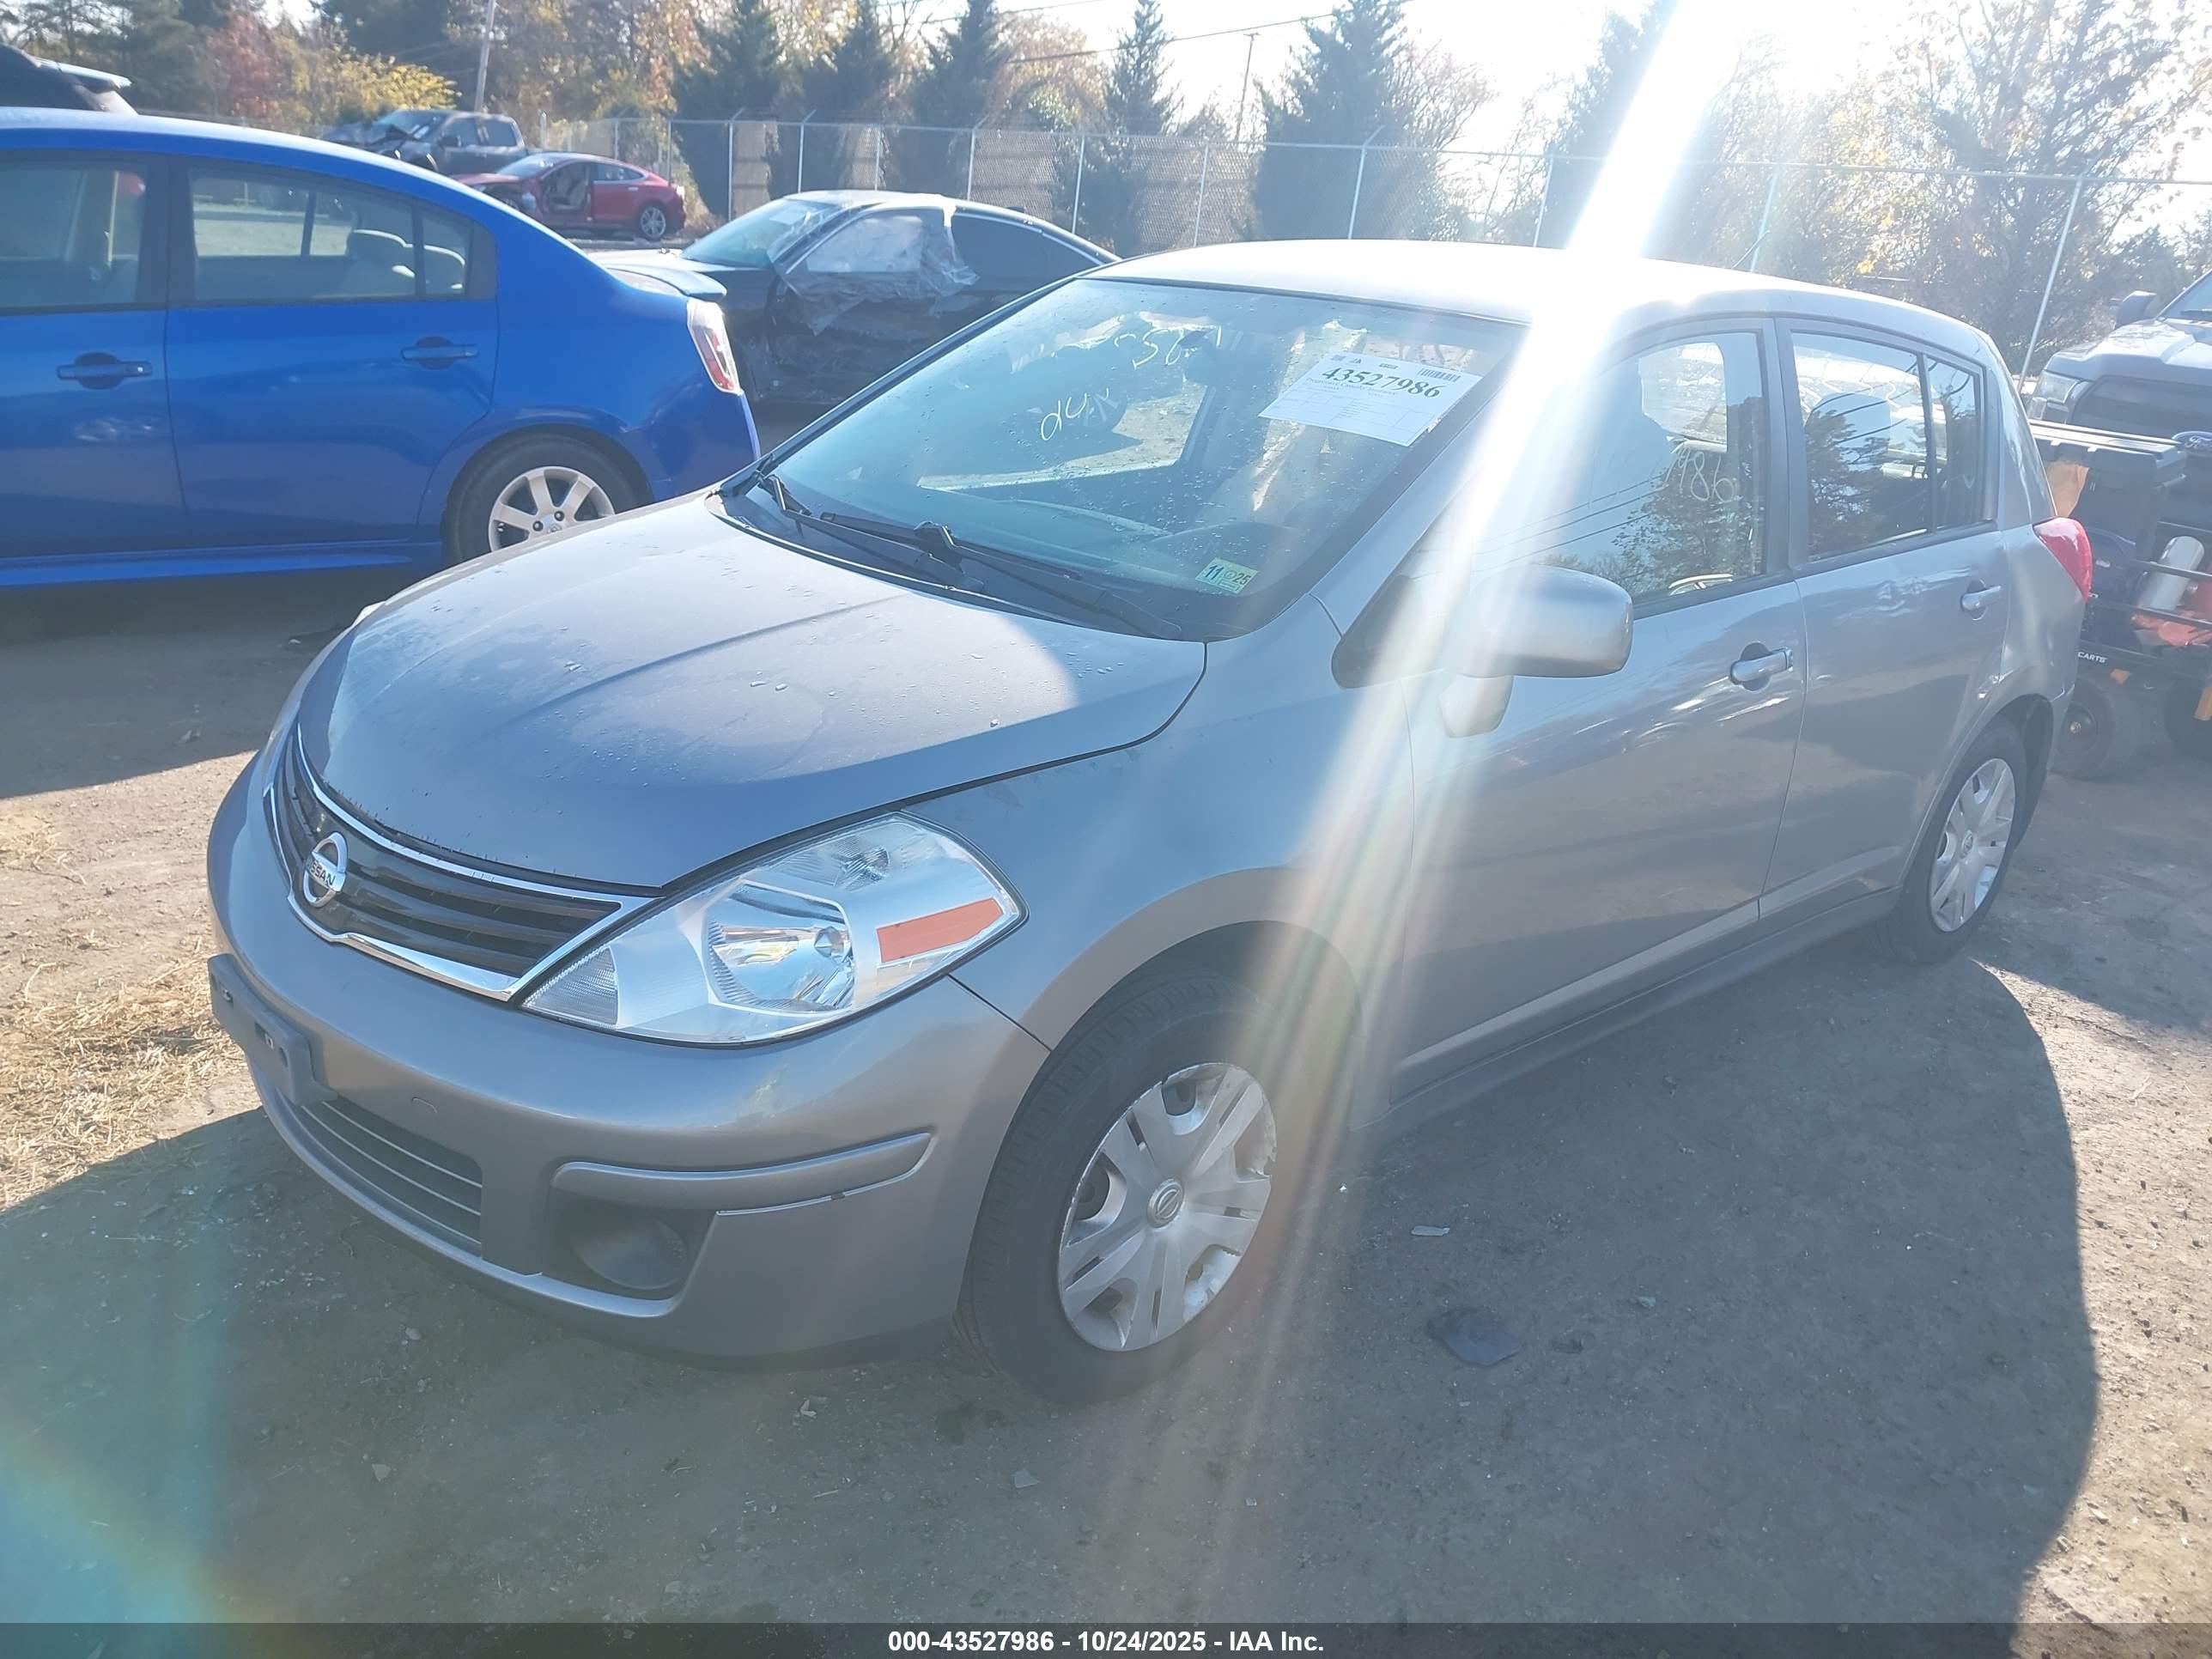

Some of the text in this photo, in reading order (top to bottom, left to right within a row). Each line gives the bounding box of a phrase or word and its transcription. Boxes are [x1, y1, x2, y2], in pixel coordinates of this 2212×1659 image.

[1322, 367, 1446, 398] 43527986
[1205, 564, 1224, 580] 11
[1232, 573, 1252, 585] 25
